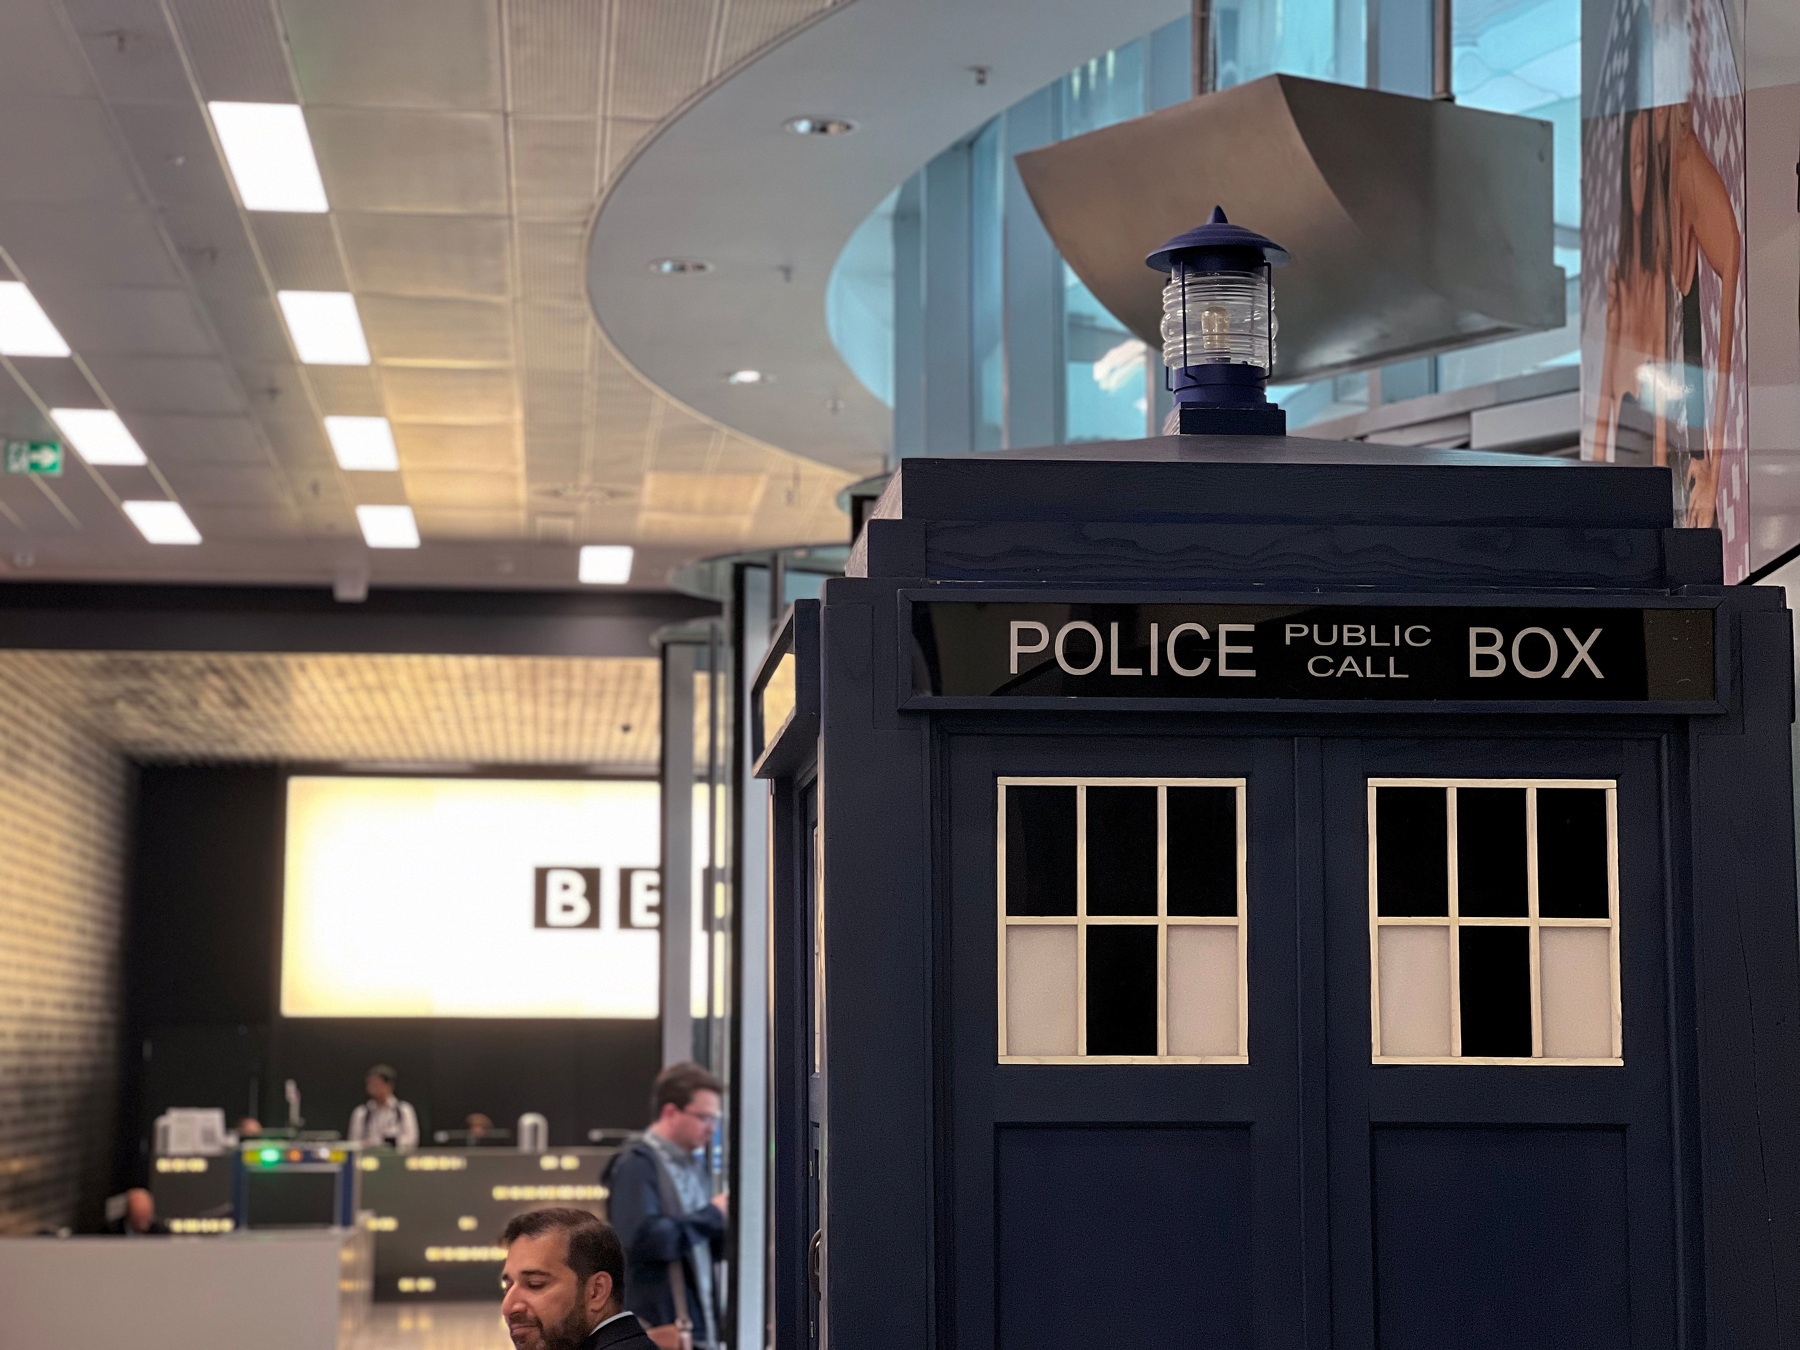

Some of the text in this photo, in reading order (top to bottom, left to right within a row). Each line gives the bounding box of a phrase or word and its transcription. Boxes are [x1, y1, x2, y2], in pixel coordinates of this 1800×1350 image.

[1009, 620, 1257, 678] POLICE
[1284, 622, 1433, 648] PUBLIC
[1469, 625, 1605, 680] BOX
[1307, 655, 1409, 679] CALL
